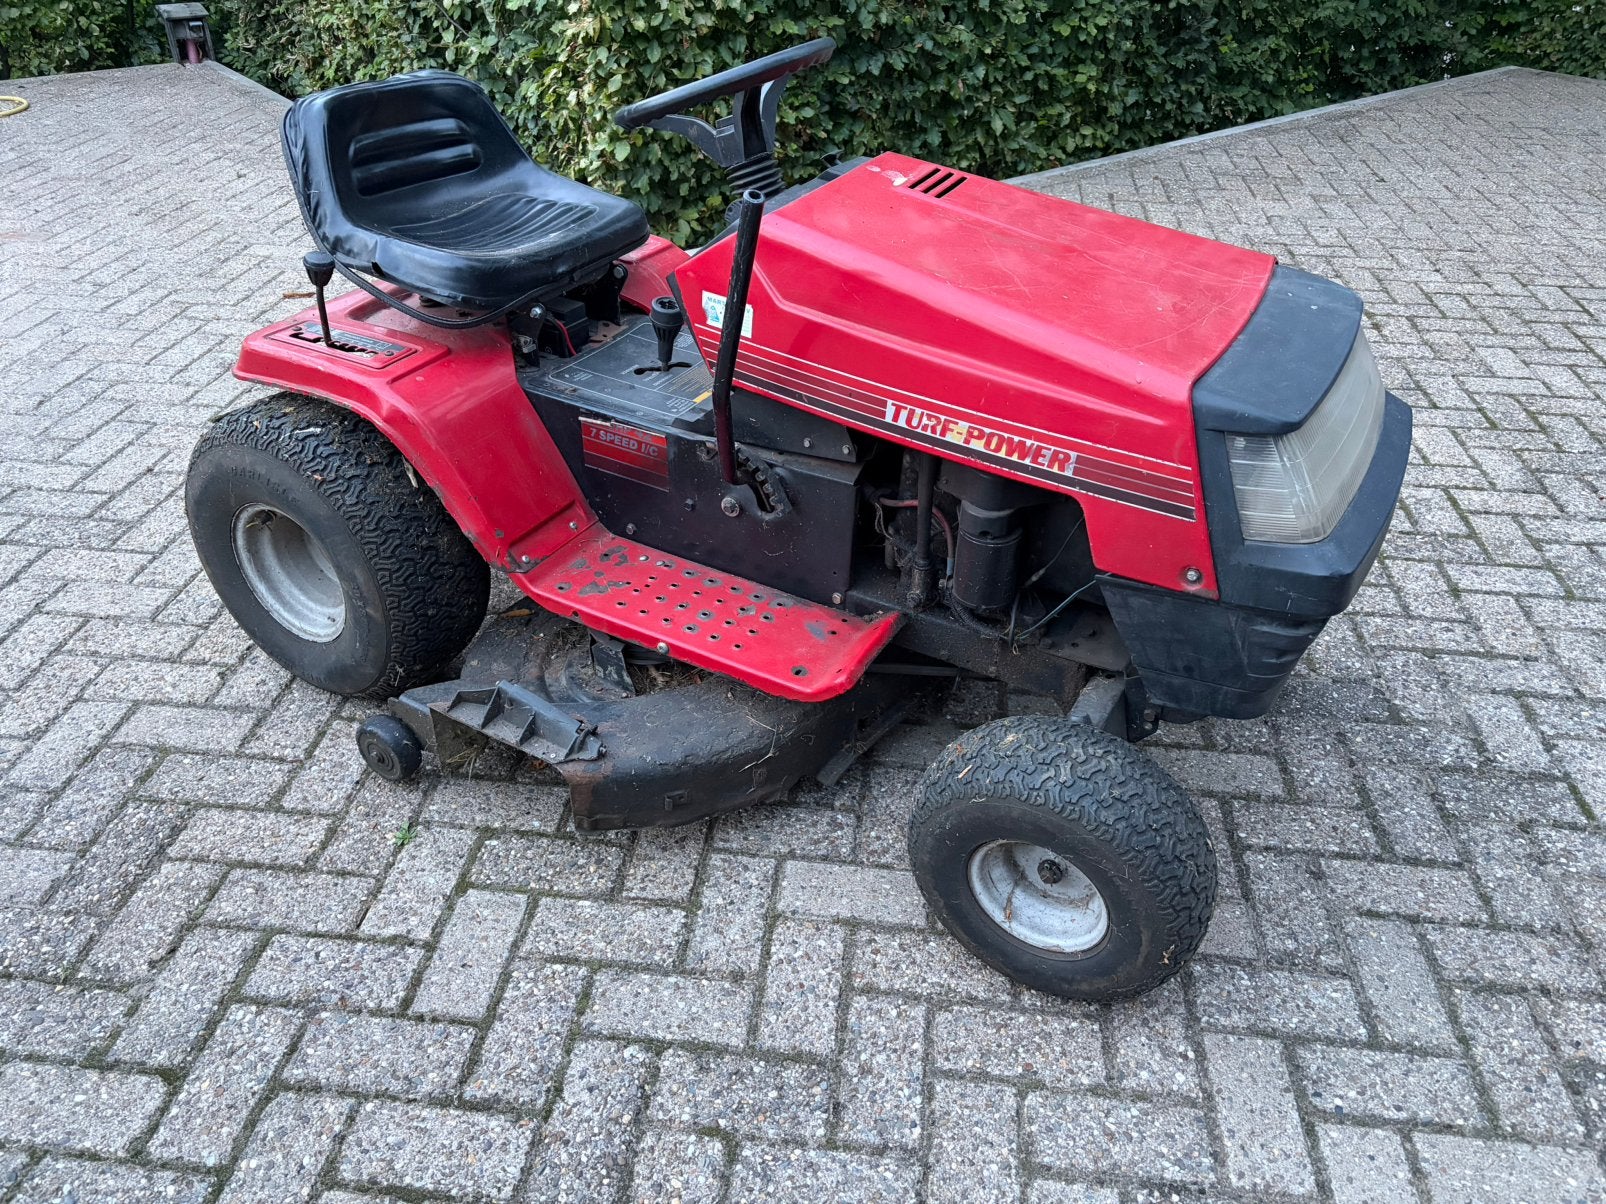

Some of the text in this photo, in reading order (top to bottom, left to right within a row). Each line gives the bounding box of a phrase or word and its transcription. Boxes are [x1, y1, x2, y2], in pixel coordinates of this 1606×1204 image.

[590, 428, 658, 456] 7 SPEED I/C
[889, 402, 1072, 473] TURF-POWER
